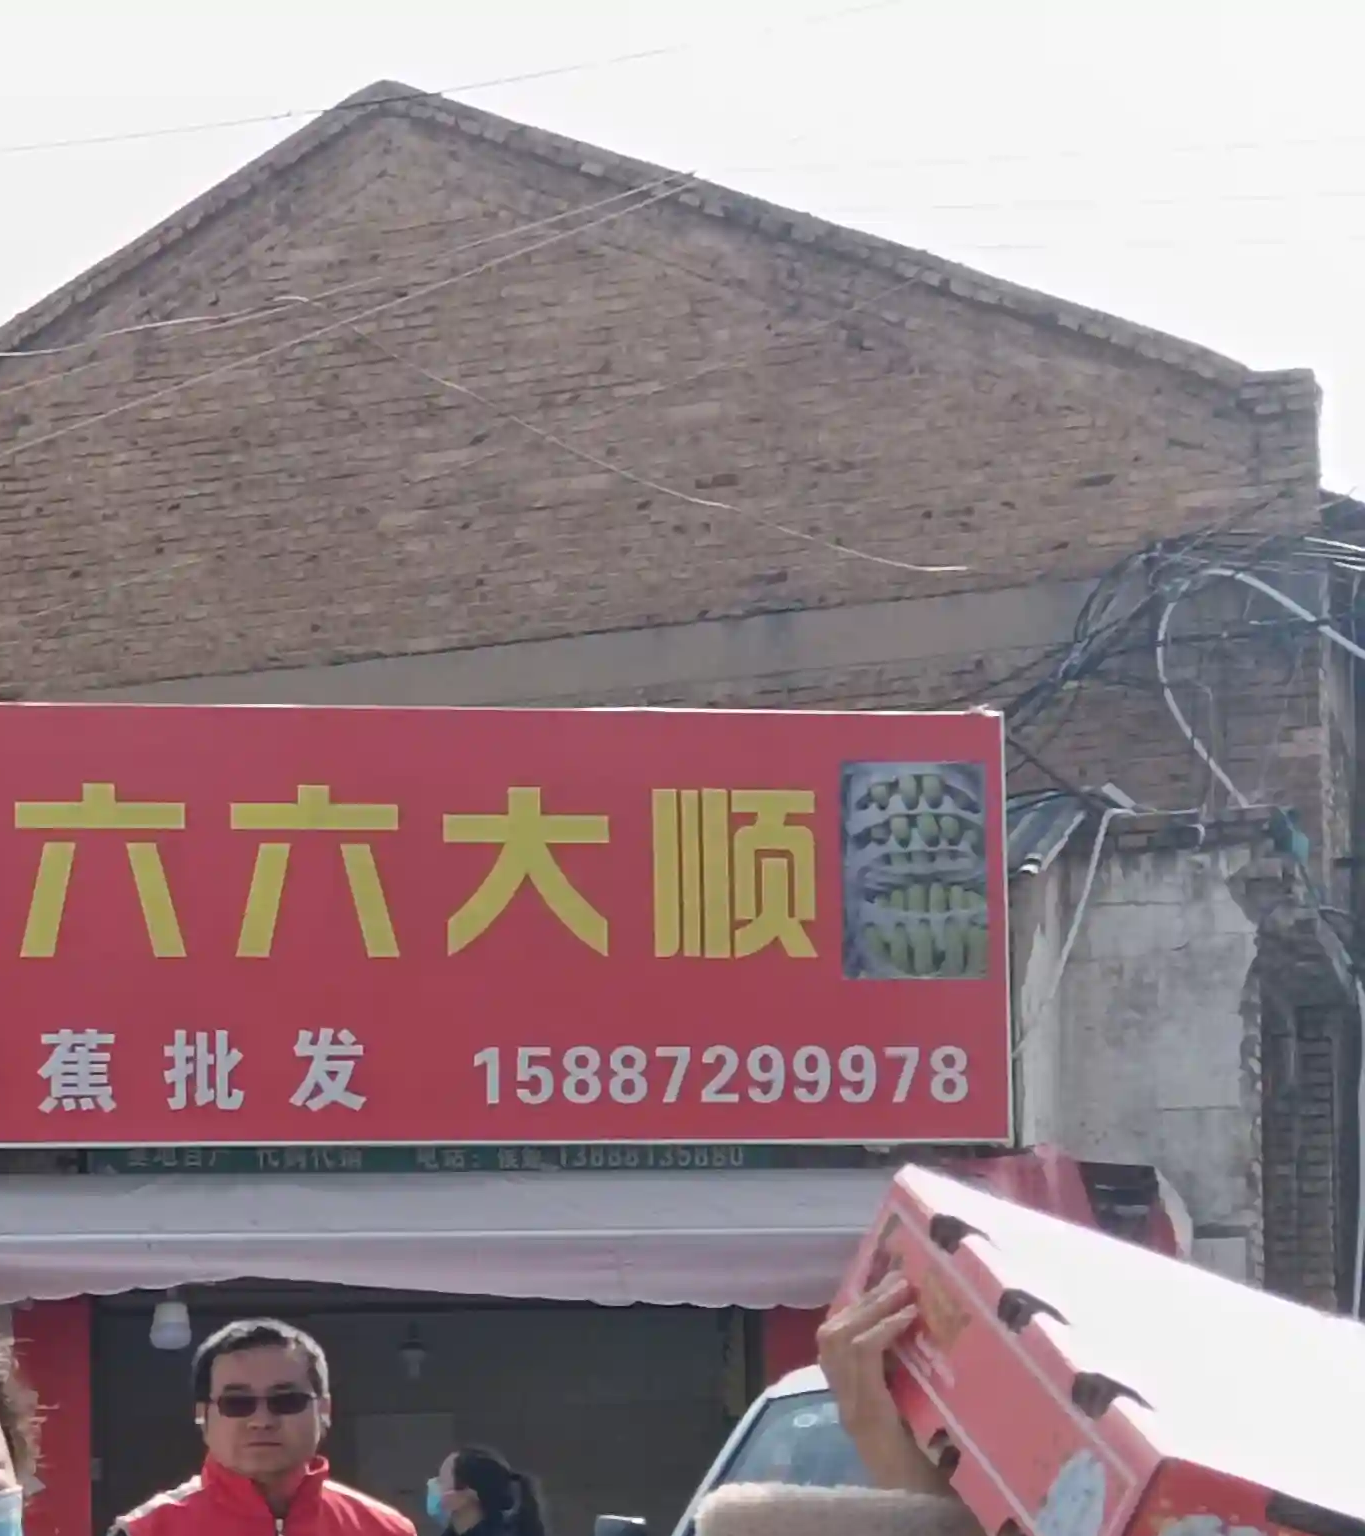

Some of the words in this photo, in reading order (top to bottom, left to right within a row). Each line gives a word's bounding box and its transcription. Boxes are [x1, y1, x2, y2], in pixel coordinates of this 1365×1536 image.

[14, 782, 817, 958] 六六大顺
[473, 1044, 970, 1105] 15887299978
